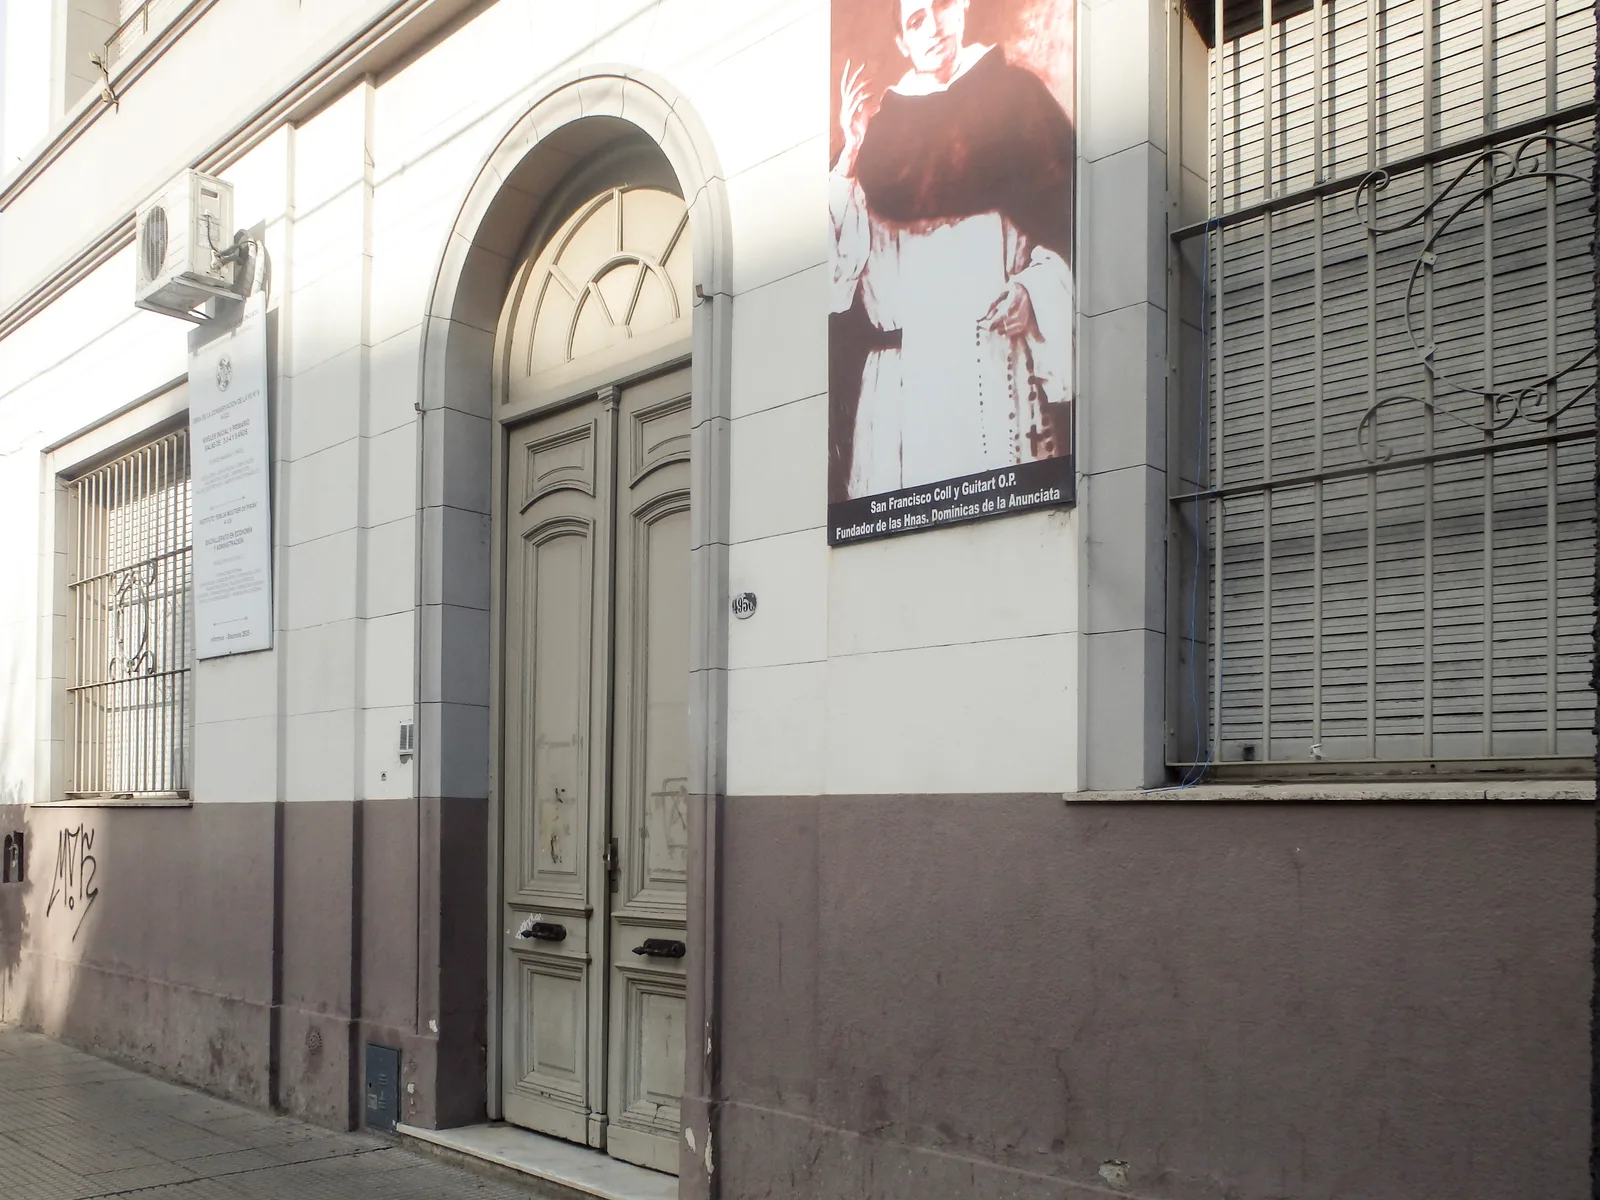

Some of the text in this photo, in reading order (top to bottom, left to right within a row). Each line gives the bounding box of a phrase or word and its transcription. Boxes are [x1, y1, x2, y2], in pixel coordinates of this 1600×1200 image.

[836, 488, 1061, 540] Fundador de las Hnas. Dominicas de la Anunciata
[870, 472, 1017, 514] San Francisco Coll y Guitart O.P.
